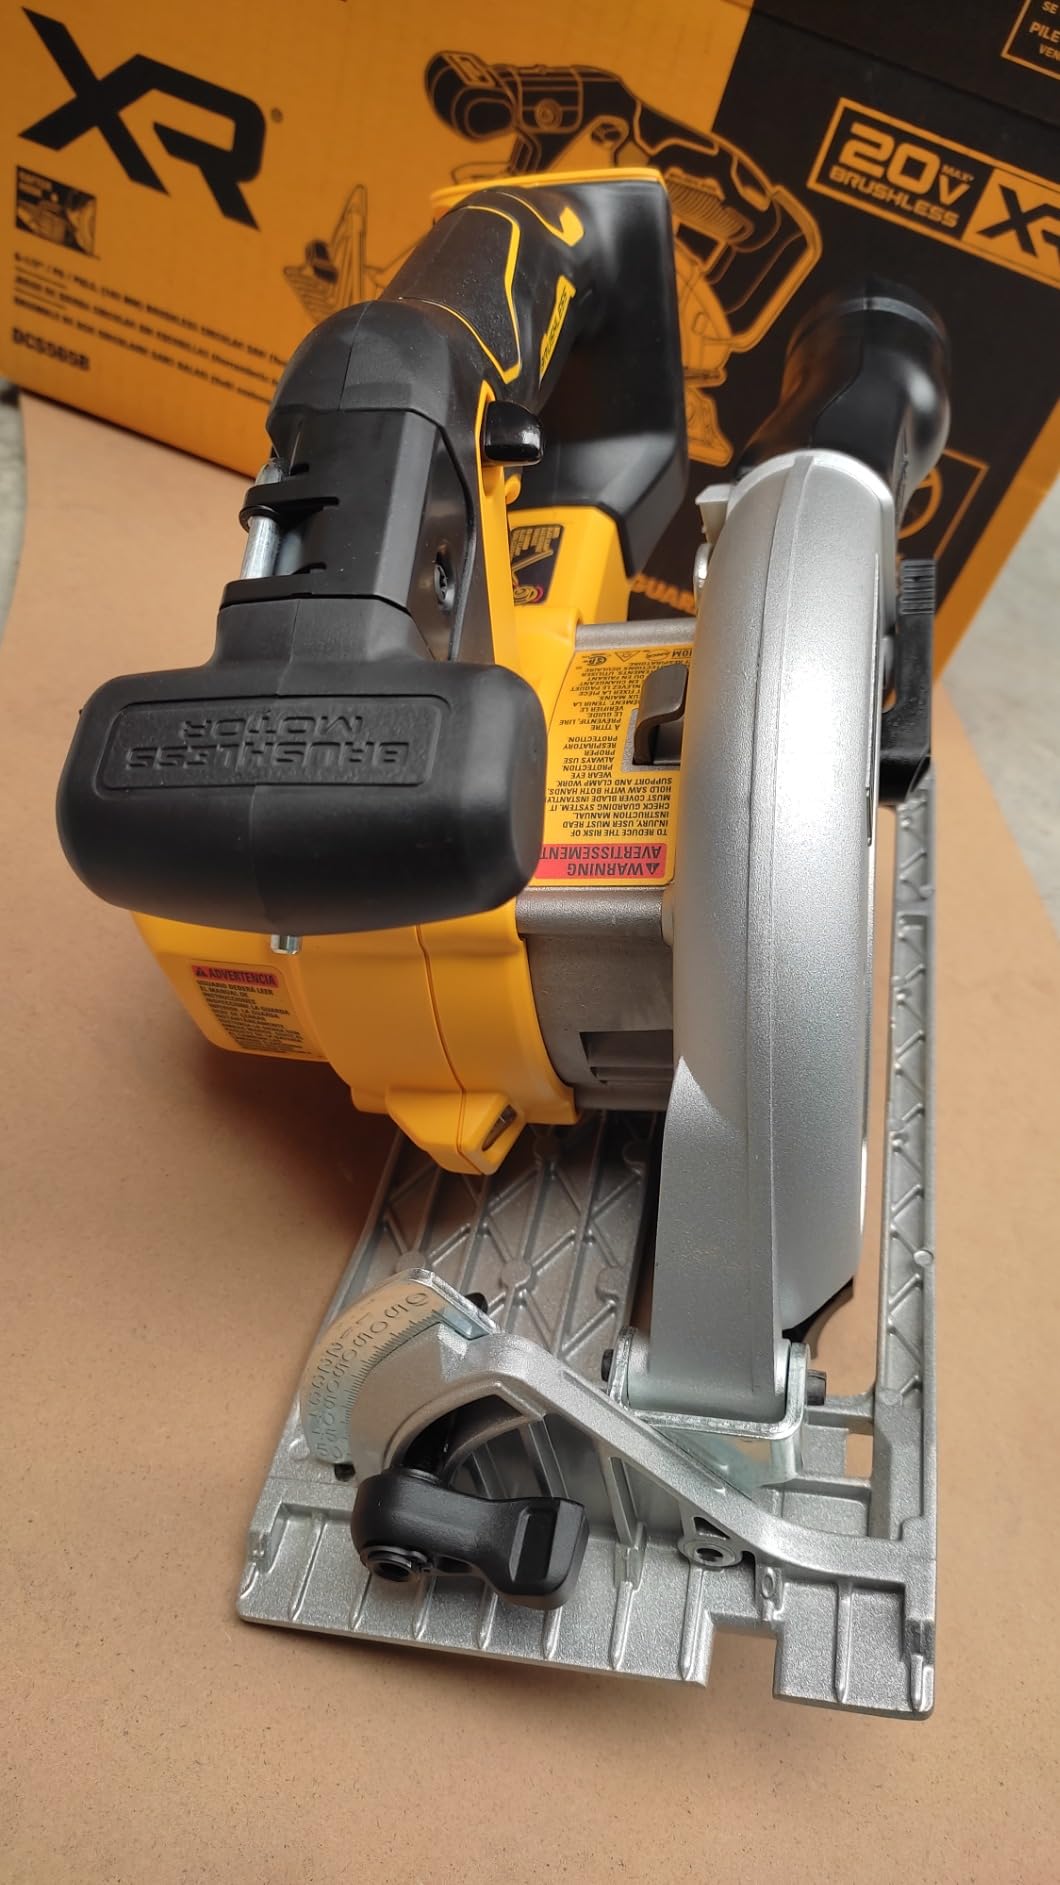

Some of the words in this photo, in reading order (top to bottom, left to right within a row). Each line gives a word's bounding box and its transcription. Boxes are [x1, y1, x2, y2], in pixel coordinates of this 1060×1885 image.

[1042, 1, 1058, 14] SE
[1029, 21, 1060, 43] PILE
[18, 6, 261, 232] XR
[829, 165, 959, 228] BRUSHLESS
[177, 715, 364, 740] MOTOR
[123, 741, 410, 772] BRUSHLESS
[613, 811, 669, 819] INSTRUCTION
[539, 846, 661, 859] AVERTISSEMENT
[567, 863, 643, 876] WARNING
[209, 968, 278, 986] ADVERTENCIA
